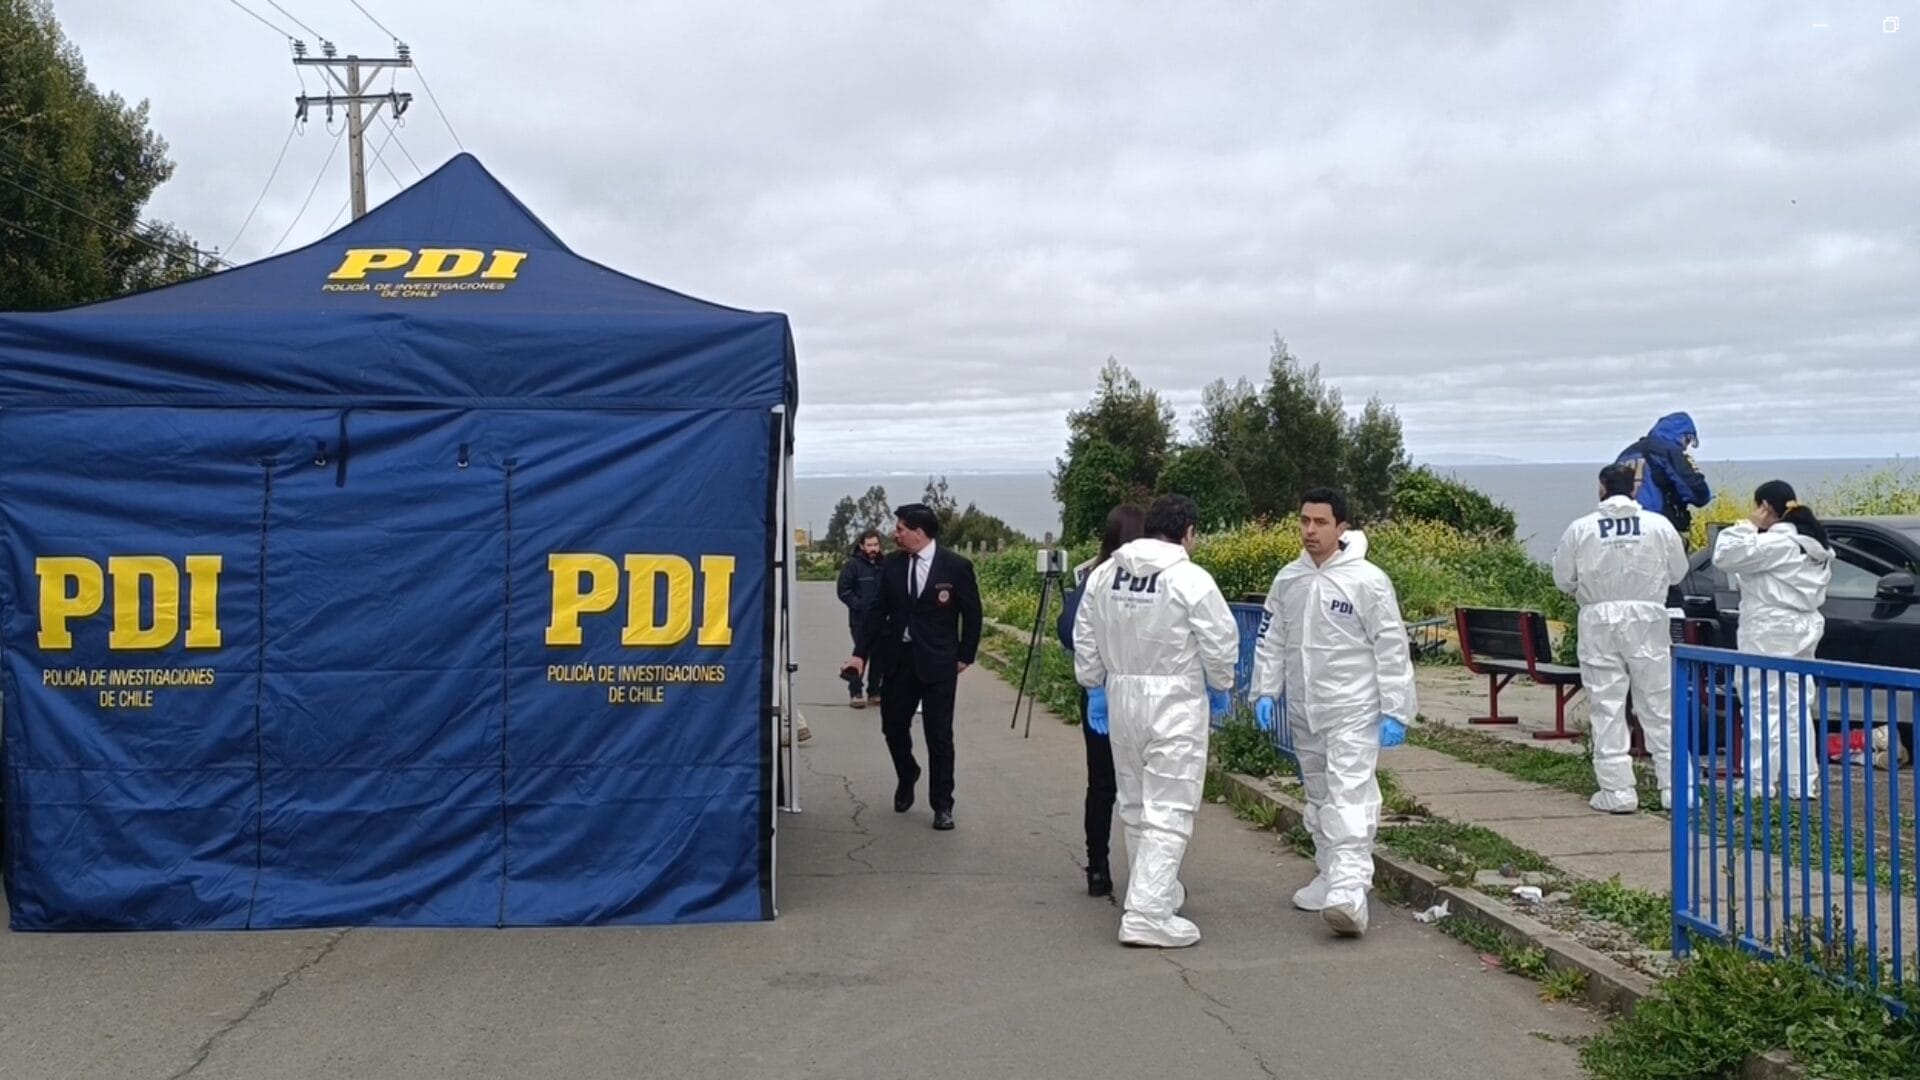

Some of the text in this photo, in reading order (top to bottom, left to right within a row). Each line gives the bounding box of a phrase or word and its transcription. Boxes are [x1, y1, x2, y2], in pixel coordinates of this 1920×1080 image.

[327, 248, 528, 279] PDI
[322, 282, 506, 292] POLICÍA DE INVESTIGACIONES
[381, 290, 439, 298] DE CHILE
[1598, 516, 1641, 538] PDI
[1111, 565, 1161, 593] PDI
[35, 555, 222, 649] PDI
[545, 553, 736, 645] PDI
[1330, 599, 1353, 615] PDI
[42, 666, 215, 686] POLICÍA DE INVESTIGACIONES
[547, 662, 725, 682] POLICÍA DE INVESTIGACIONES
[100, 690, 154, 707] DE CHILE
[608, 686, 664, 703] DE CHILE
